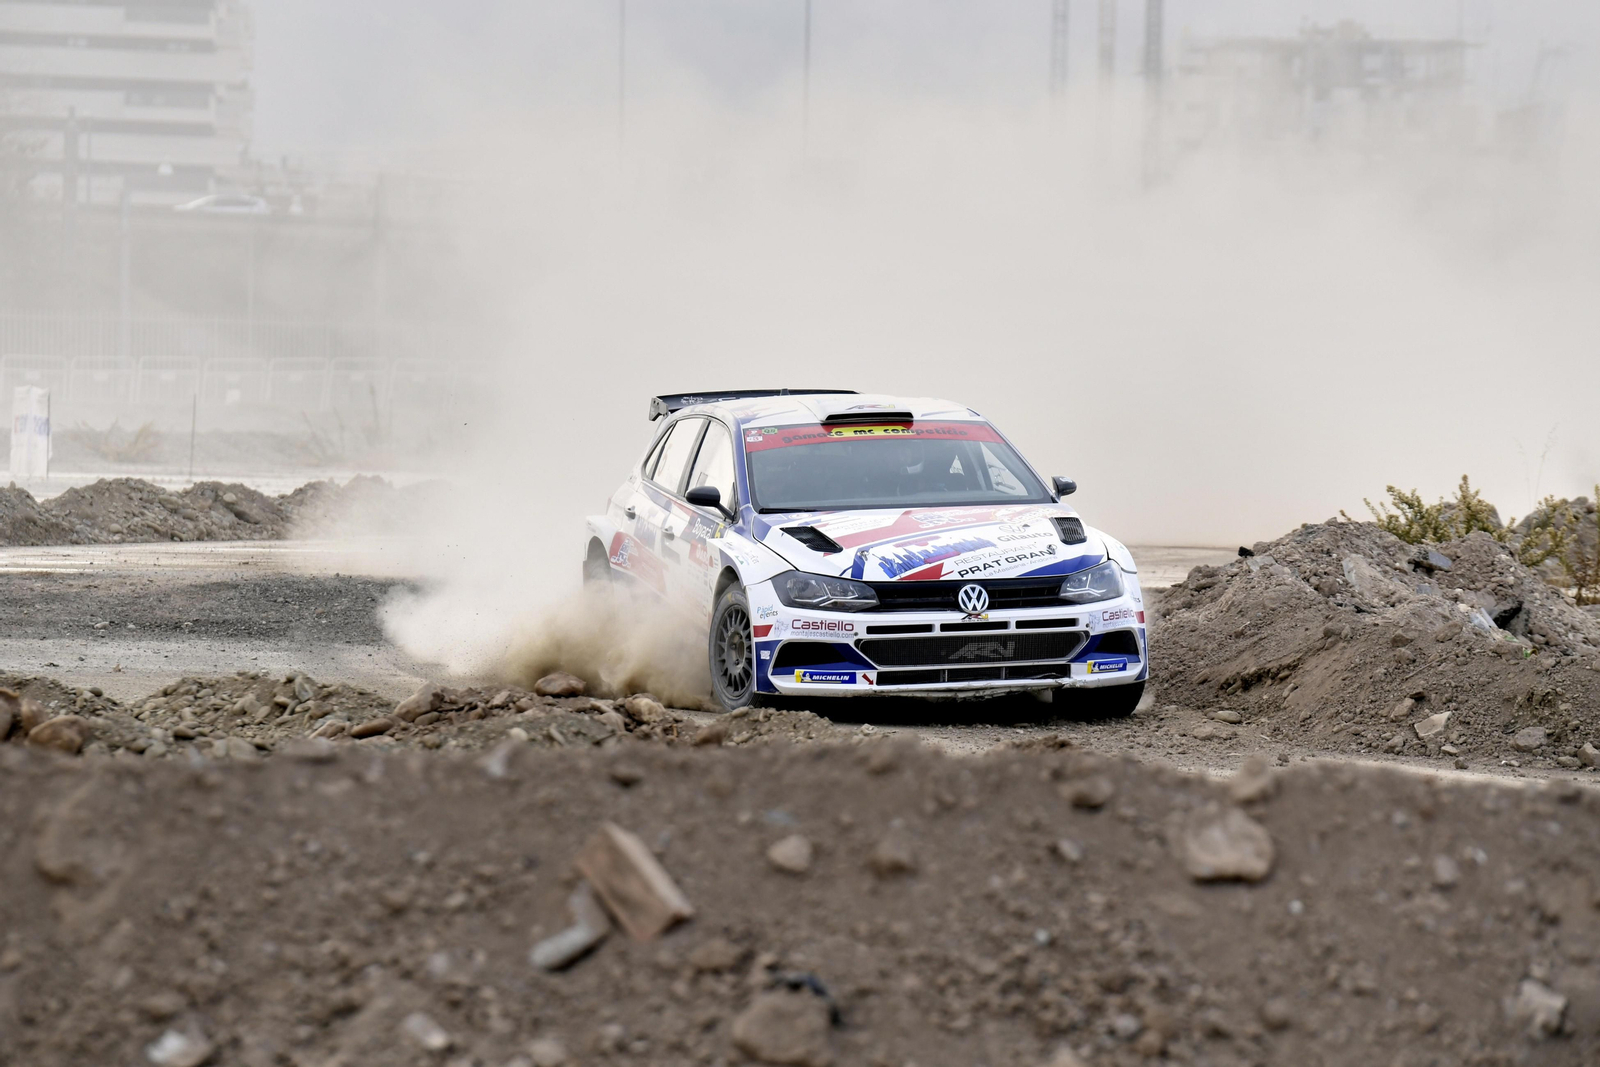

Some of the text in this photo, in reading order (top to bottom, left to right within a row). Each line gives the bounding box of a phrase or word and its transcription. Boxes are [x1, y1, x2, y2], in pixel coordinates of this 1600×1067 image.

[853, 427, 876, 436] mc
[996, 532, 1054, 542] Gilauto
[953, 542, 1038, 567] RESTAURANT
[957, 559, 1005, 578] PRAT
[791, 619, 855, 632] Castiello
